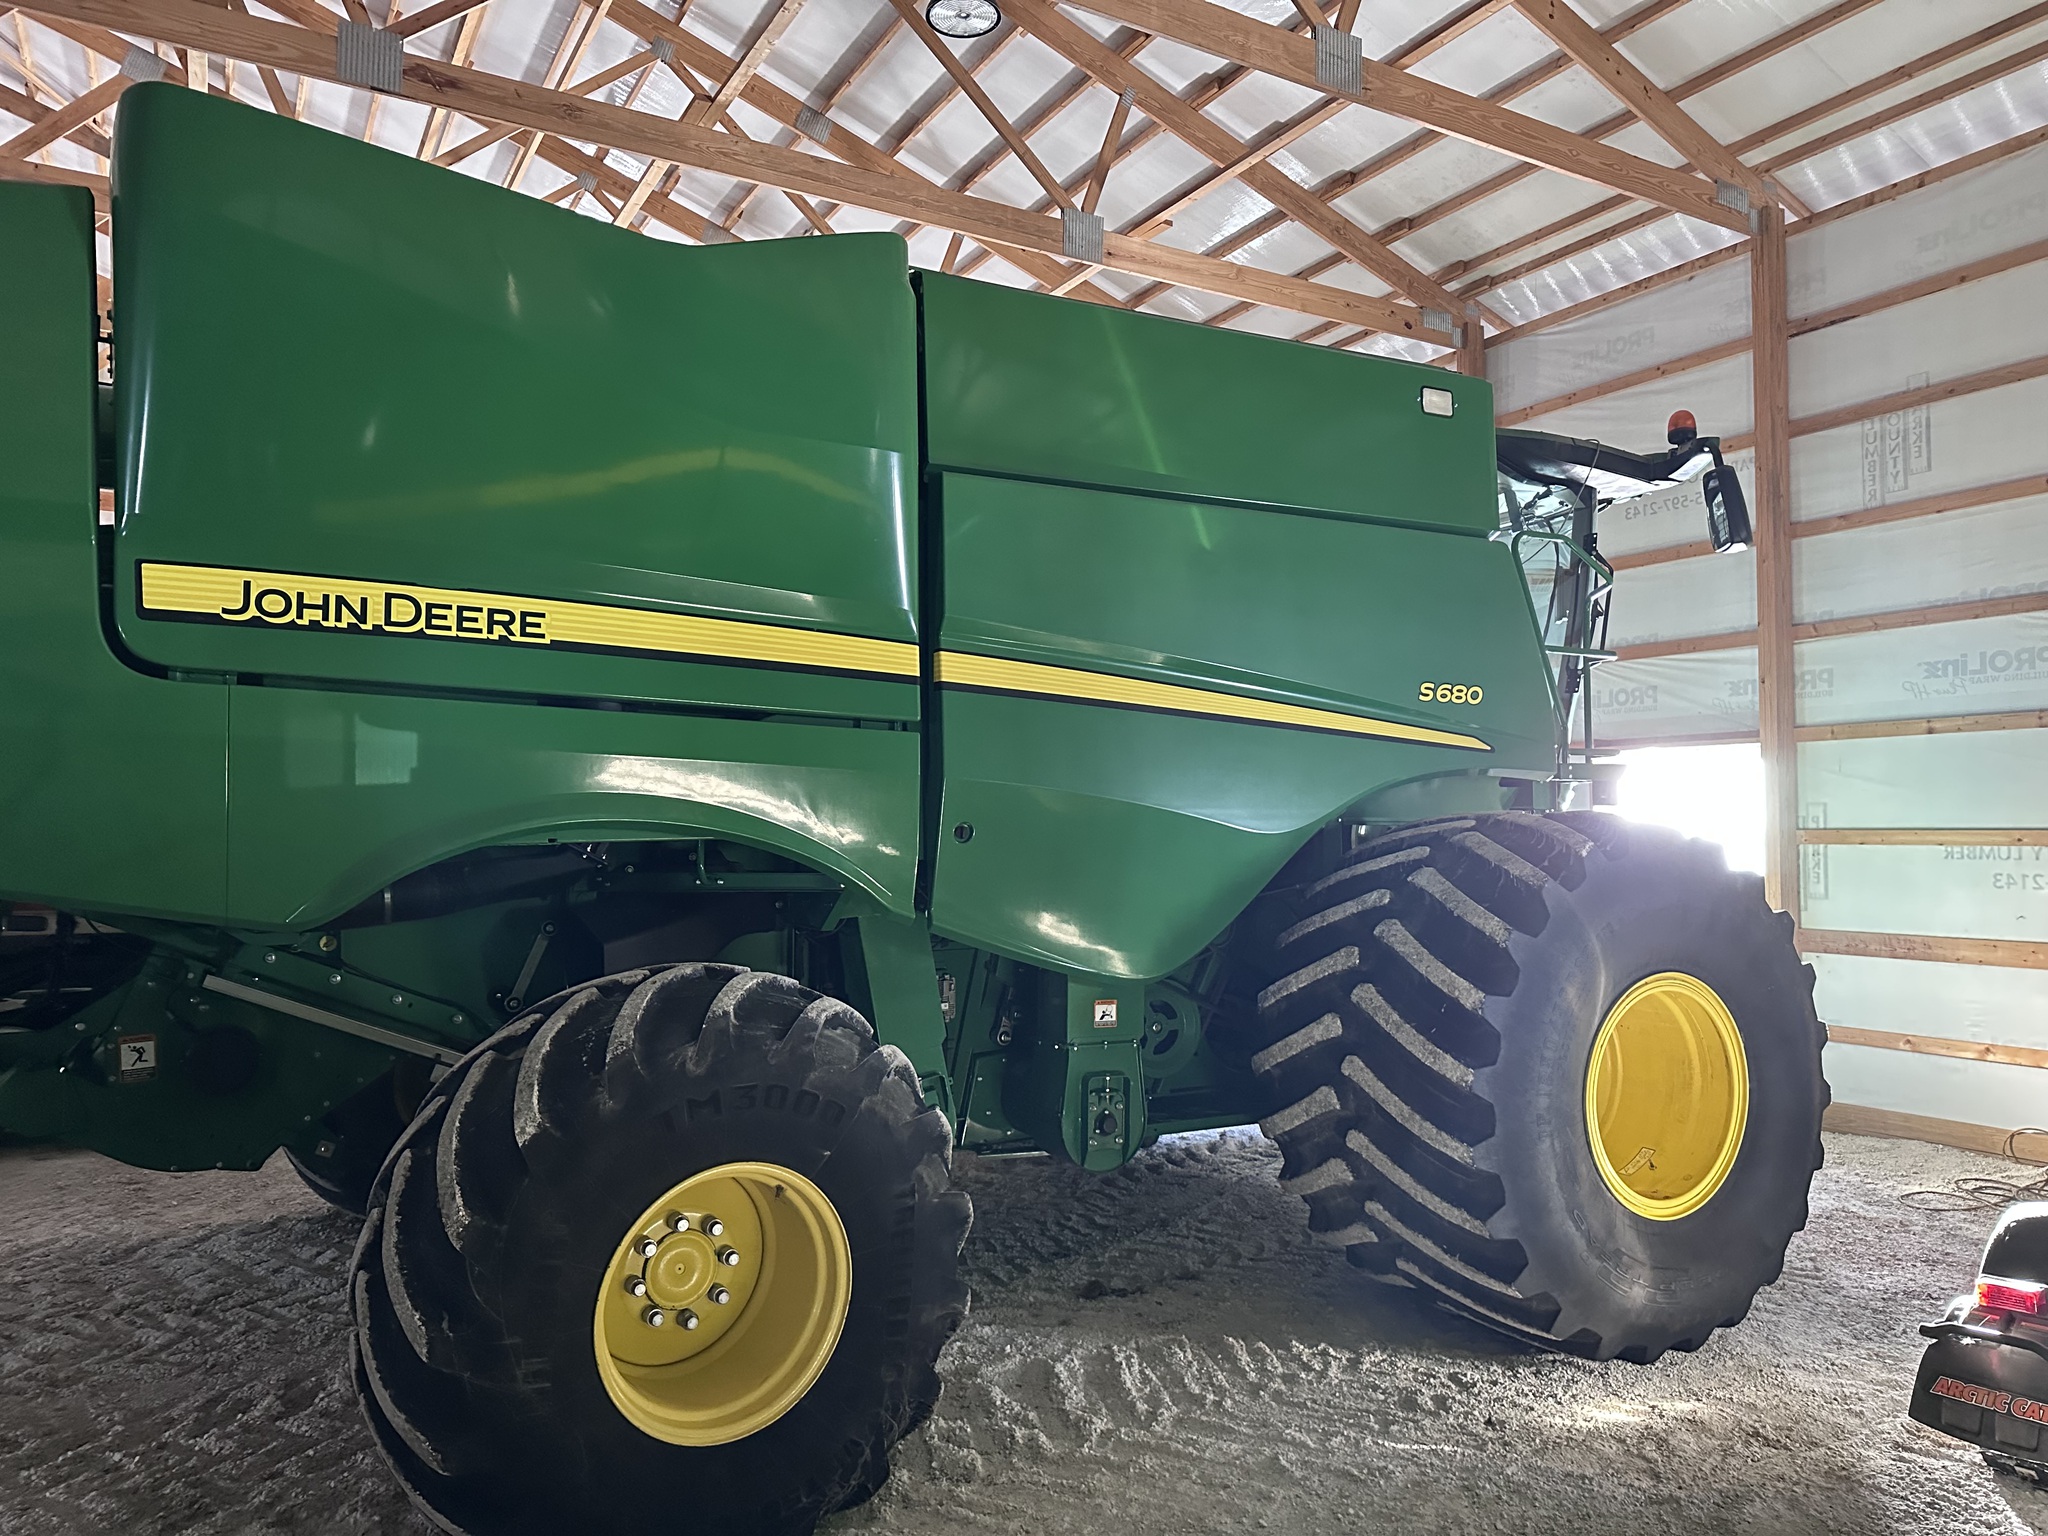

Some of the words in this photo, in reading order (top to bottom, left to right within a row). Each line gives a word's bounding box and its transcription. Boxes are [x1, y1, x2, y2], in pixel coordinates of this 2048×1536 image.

[221, 579, 369, 627] JOHN
[384, 591, 548, 641] DEERE
[1418, 681, 1484, 705] S680
[1930, 1375, 2012, 1413] ARCTIC
